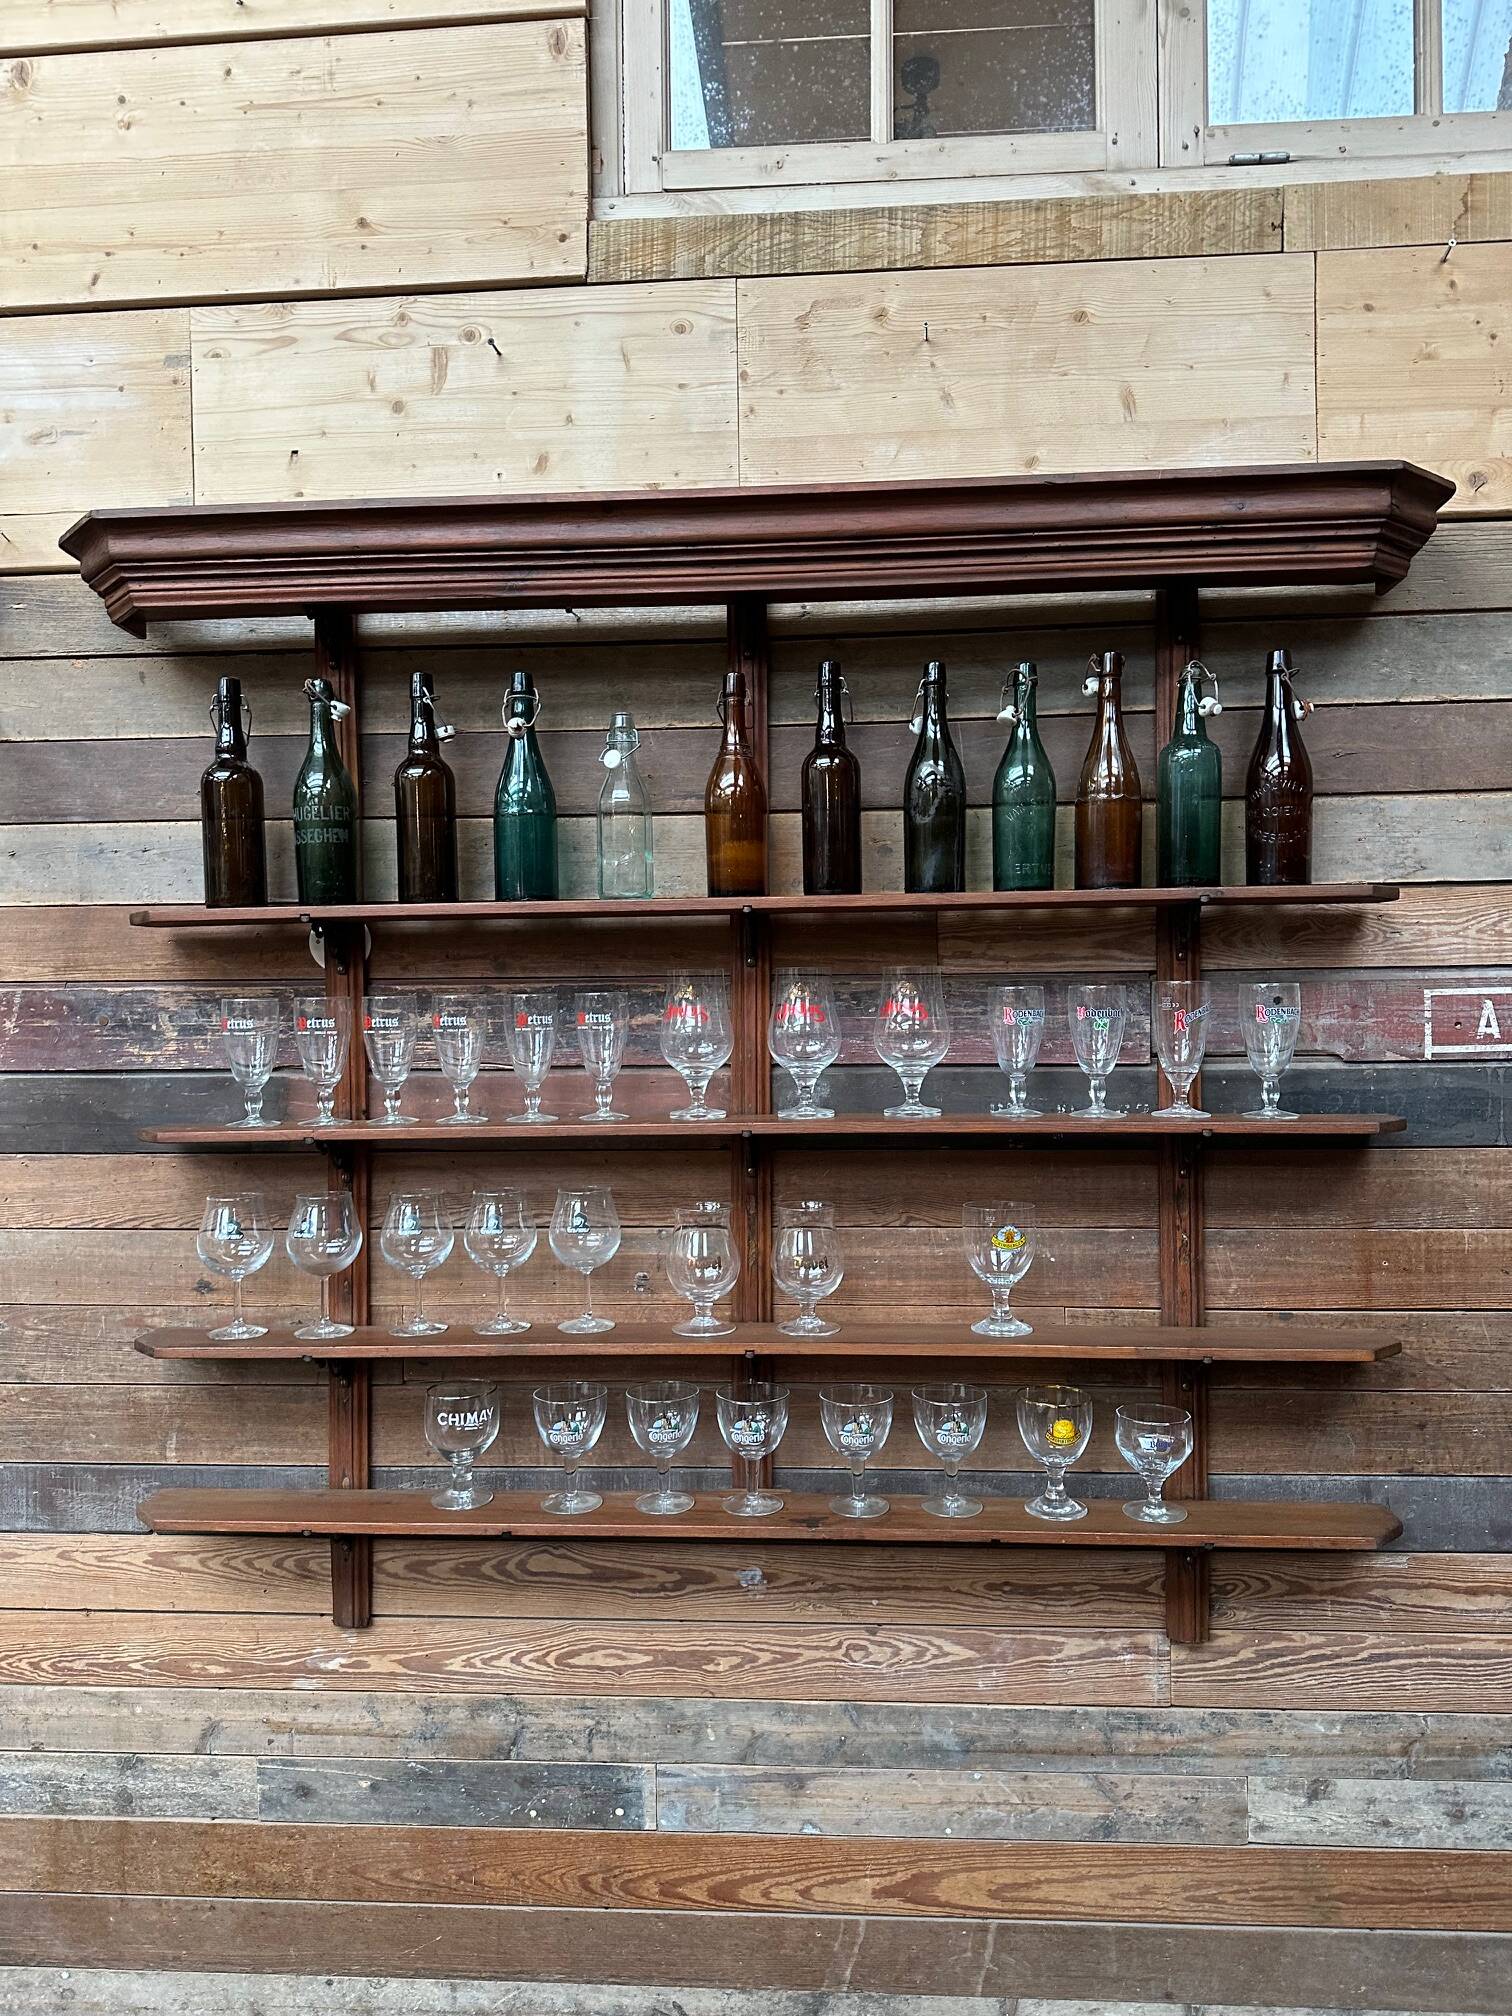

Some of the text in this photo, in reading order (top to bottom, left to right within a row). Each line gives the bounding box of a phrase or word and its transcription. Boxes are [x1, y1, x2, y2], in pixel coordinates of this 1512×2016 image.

[1475, 999, 1502, 1040] A
[437, 1407, 494, 1426] CHIMAY
[548, 1429, 583, 1445] Tongerlo
[647, 1428, 683, 1445] Tongerlo
[730, 1428, 765, 1445] Tongerlo
[839, 1430, 874, 1447] Tongerlo
[935, 1429, 971, 1446] Tongerlo
